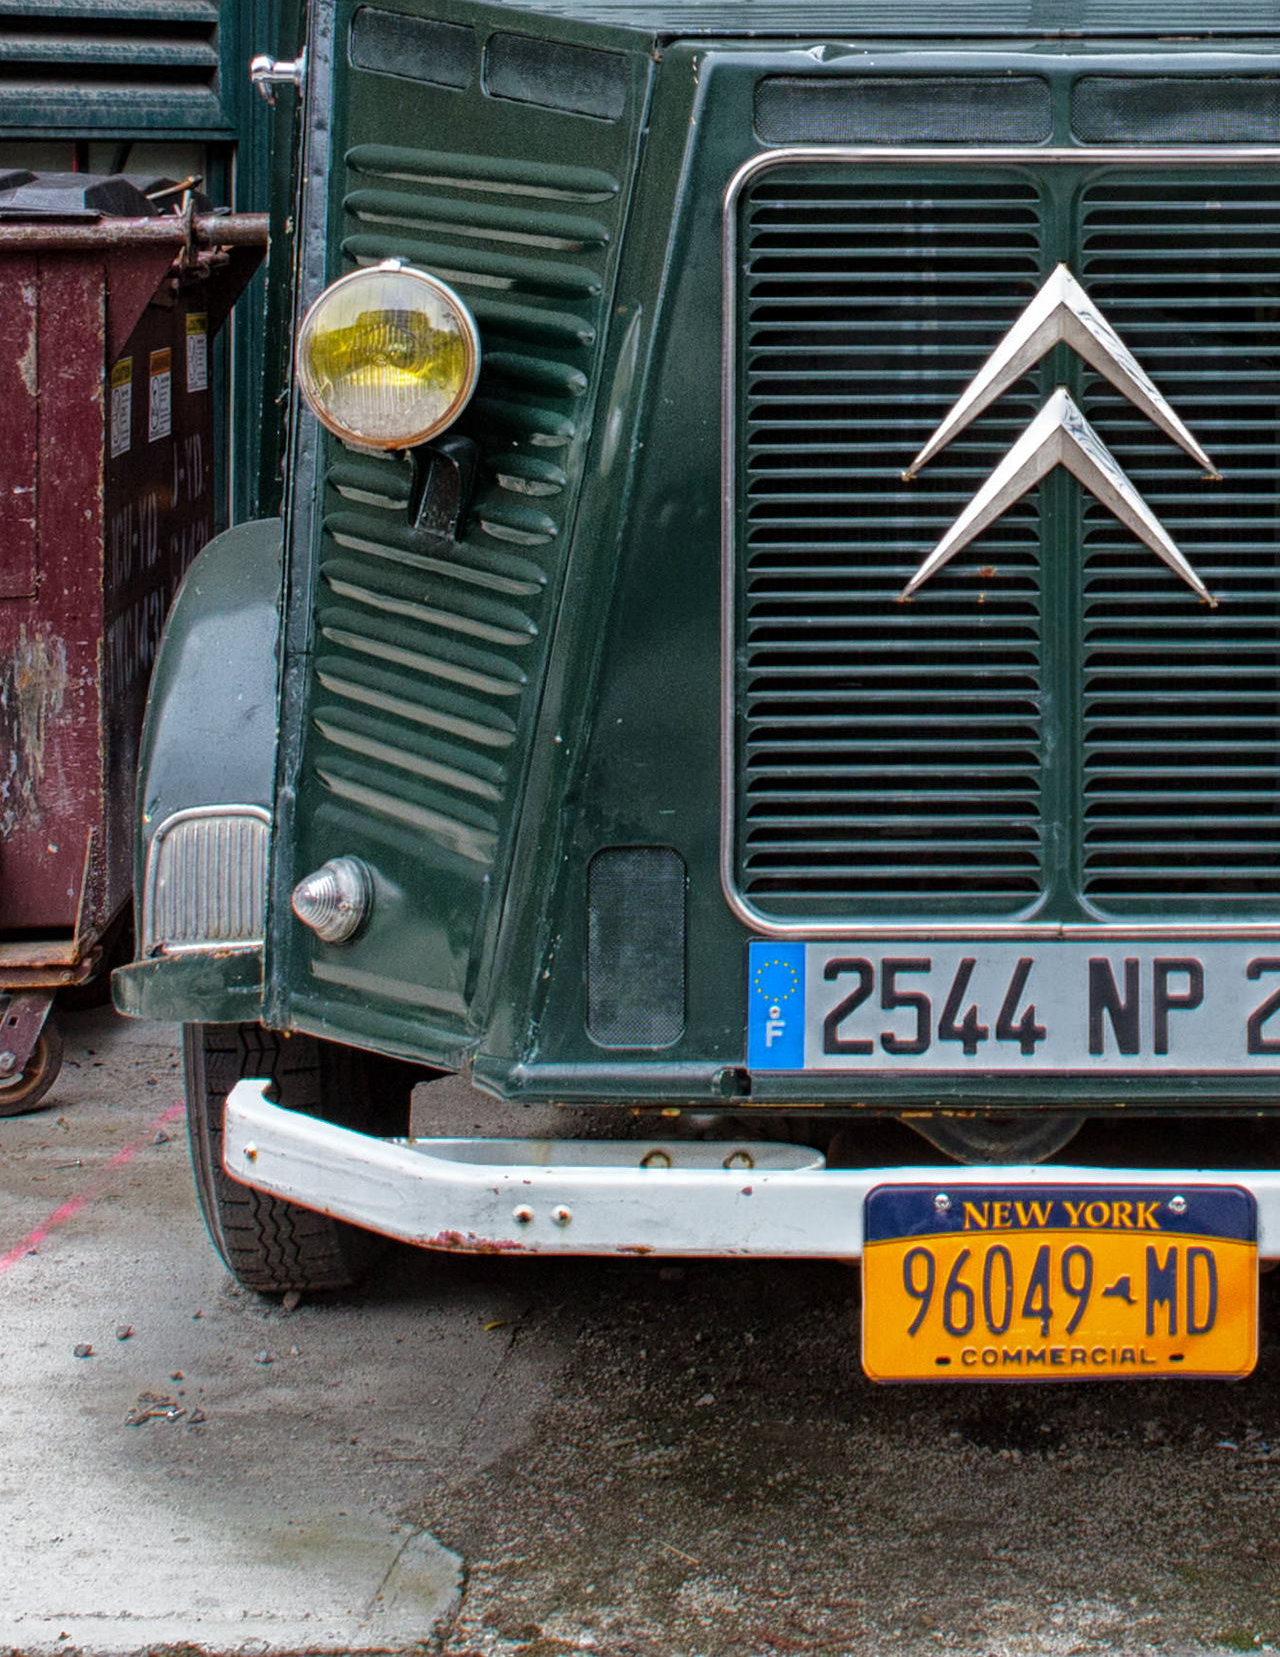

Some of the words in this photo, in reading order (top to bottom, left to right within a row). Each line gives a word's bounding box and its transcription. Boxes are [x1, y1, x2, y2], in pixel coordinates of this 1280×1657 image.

[765, 1020, 786, 1048] F
[822, 957, 1047, 1056] 2544
[1088, 957, 1205, 1056] NP
[963, 1201, 1052, 1230] NEW
[1062, 1201, 1162, 1230] YORK
[902, 1243, 1094, 1338] 96049
[1145, 1244, 1219, 1337] MD
[960, 1346, 1157, 1368] COMMERCIAL
